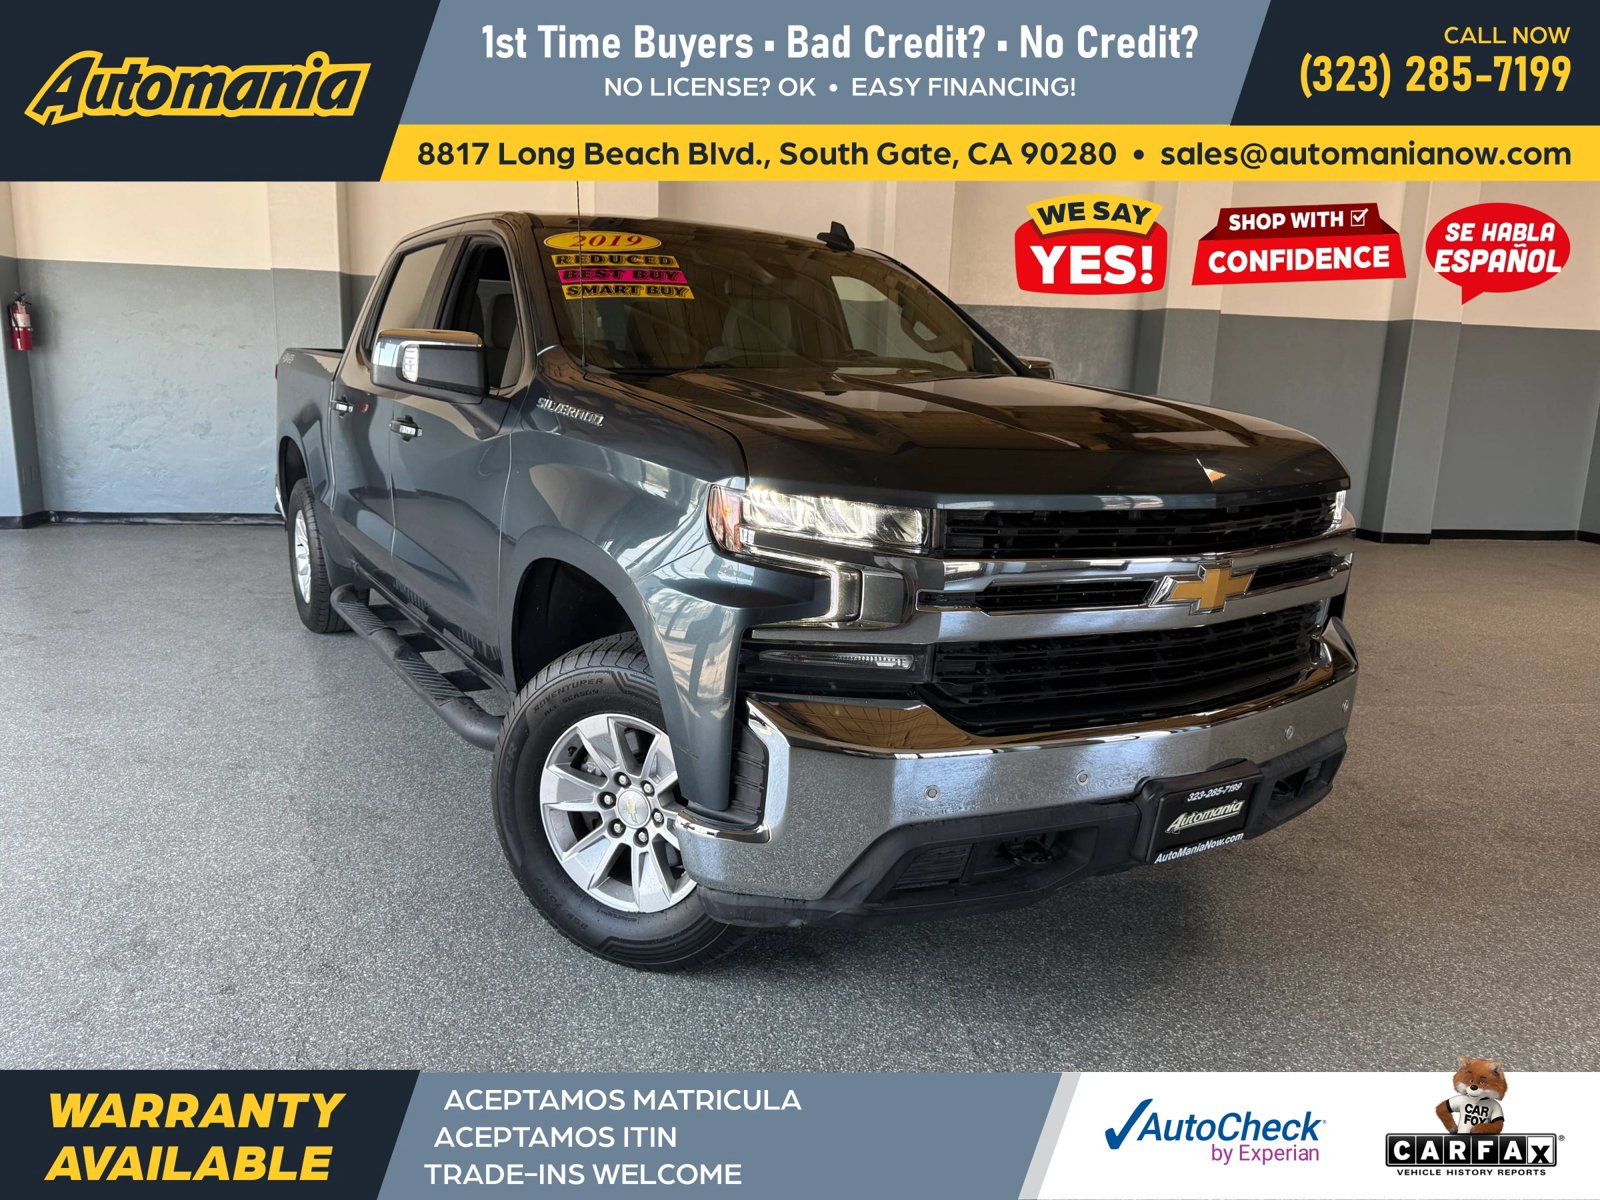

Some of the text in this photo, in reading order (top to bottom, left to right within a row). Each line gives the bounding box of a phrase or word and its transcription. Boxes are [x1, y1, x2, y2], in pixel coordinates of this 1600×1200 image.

[569, 235, 642, 247] 2019
[556, 255, 676, 265] REDUCED
[563, 270, 679, 280] BEST BUY
[566, 286, 688, 297] SMART BUY
[1187, 782, 1243, 802] 323-285-7199
[1165, 799, 1246, 834] Automania
[1153, 832, 1245, 864] AutoManiaNow.com
